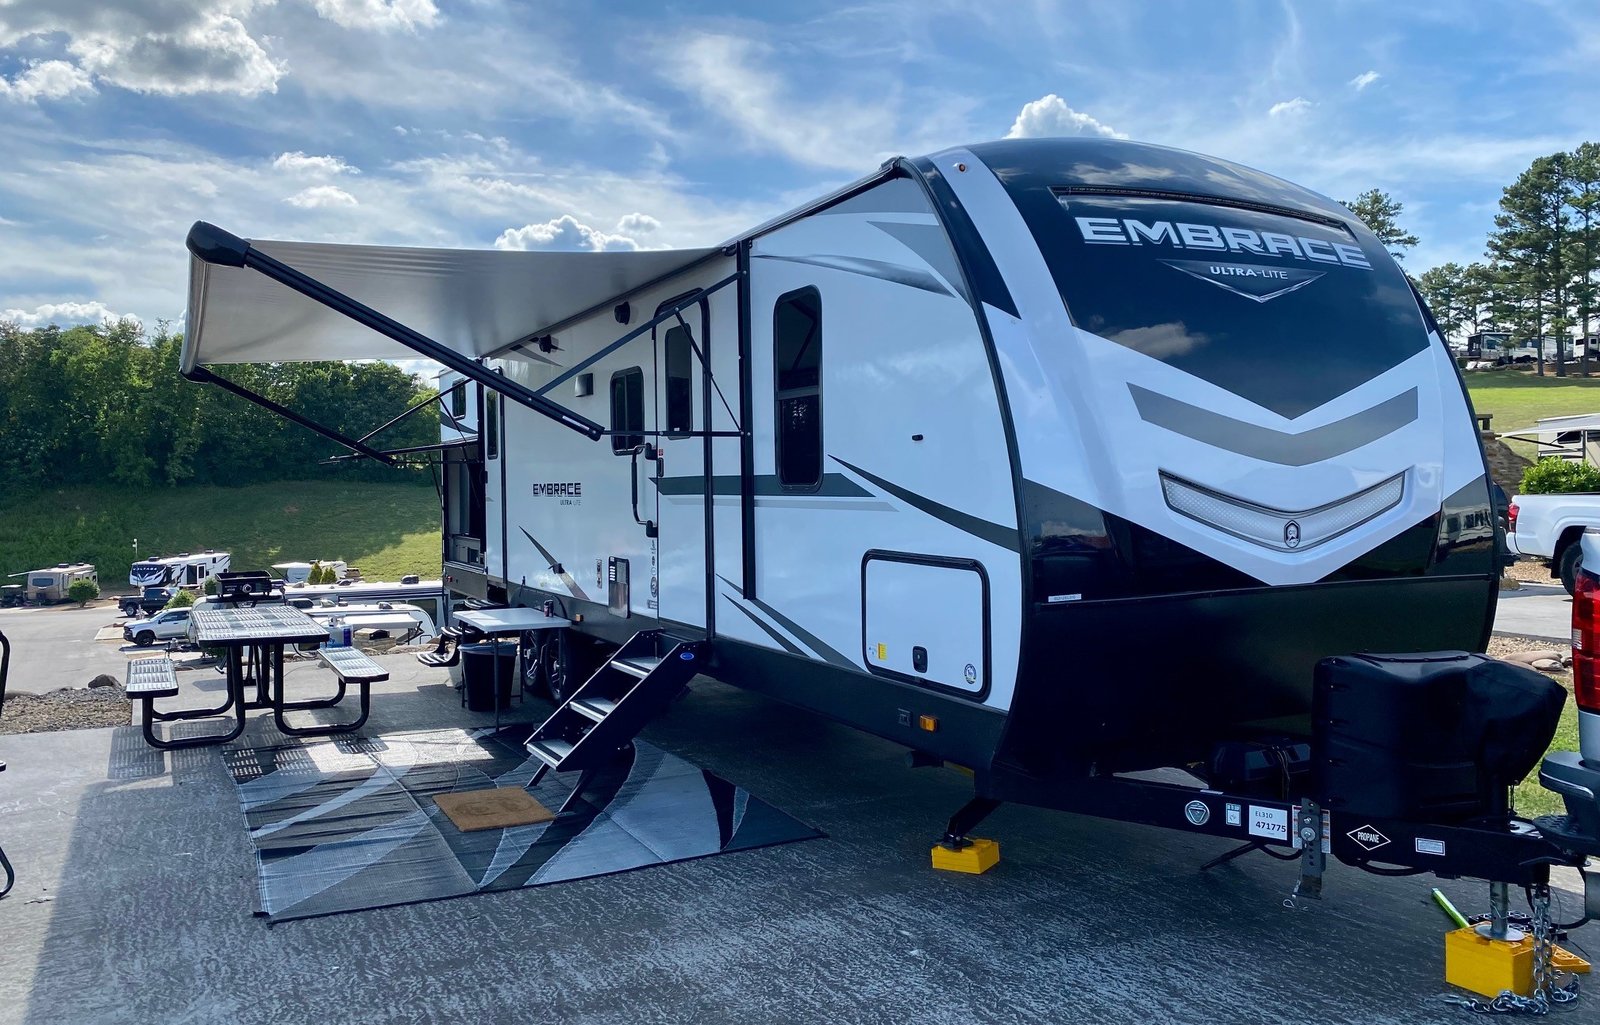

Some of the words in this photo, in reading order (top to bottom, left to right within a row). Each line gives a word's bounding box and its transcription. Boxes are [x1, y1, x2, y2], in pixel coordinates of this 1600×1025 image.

[1074, 216, 1374, 271] EMBRACE
[1209, 266, 1289, 280] ULTRA-LITE
[533, 482, 582, 497] EMBRACE
[1255, 810, 1274, 819] EL310
[1255, 821, 1287, 833] 471775
[1357, 831, 1380, 844] PROPANE
